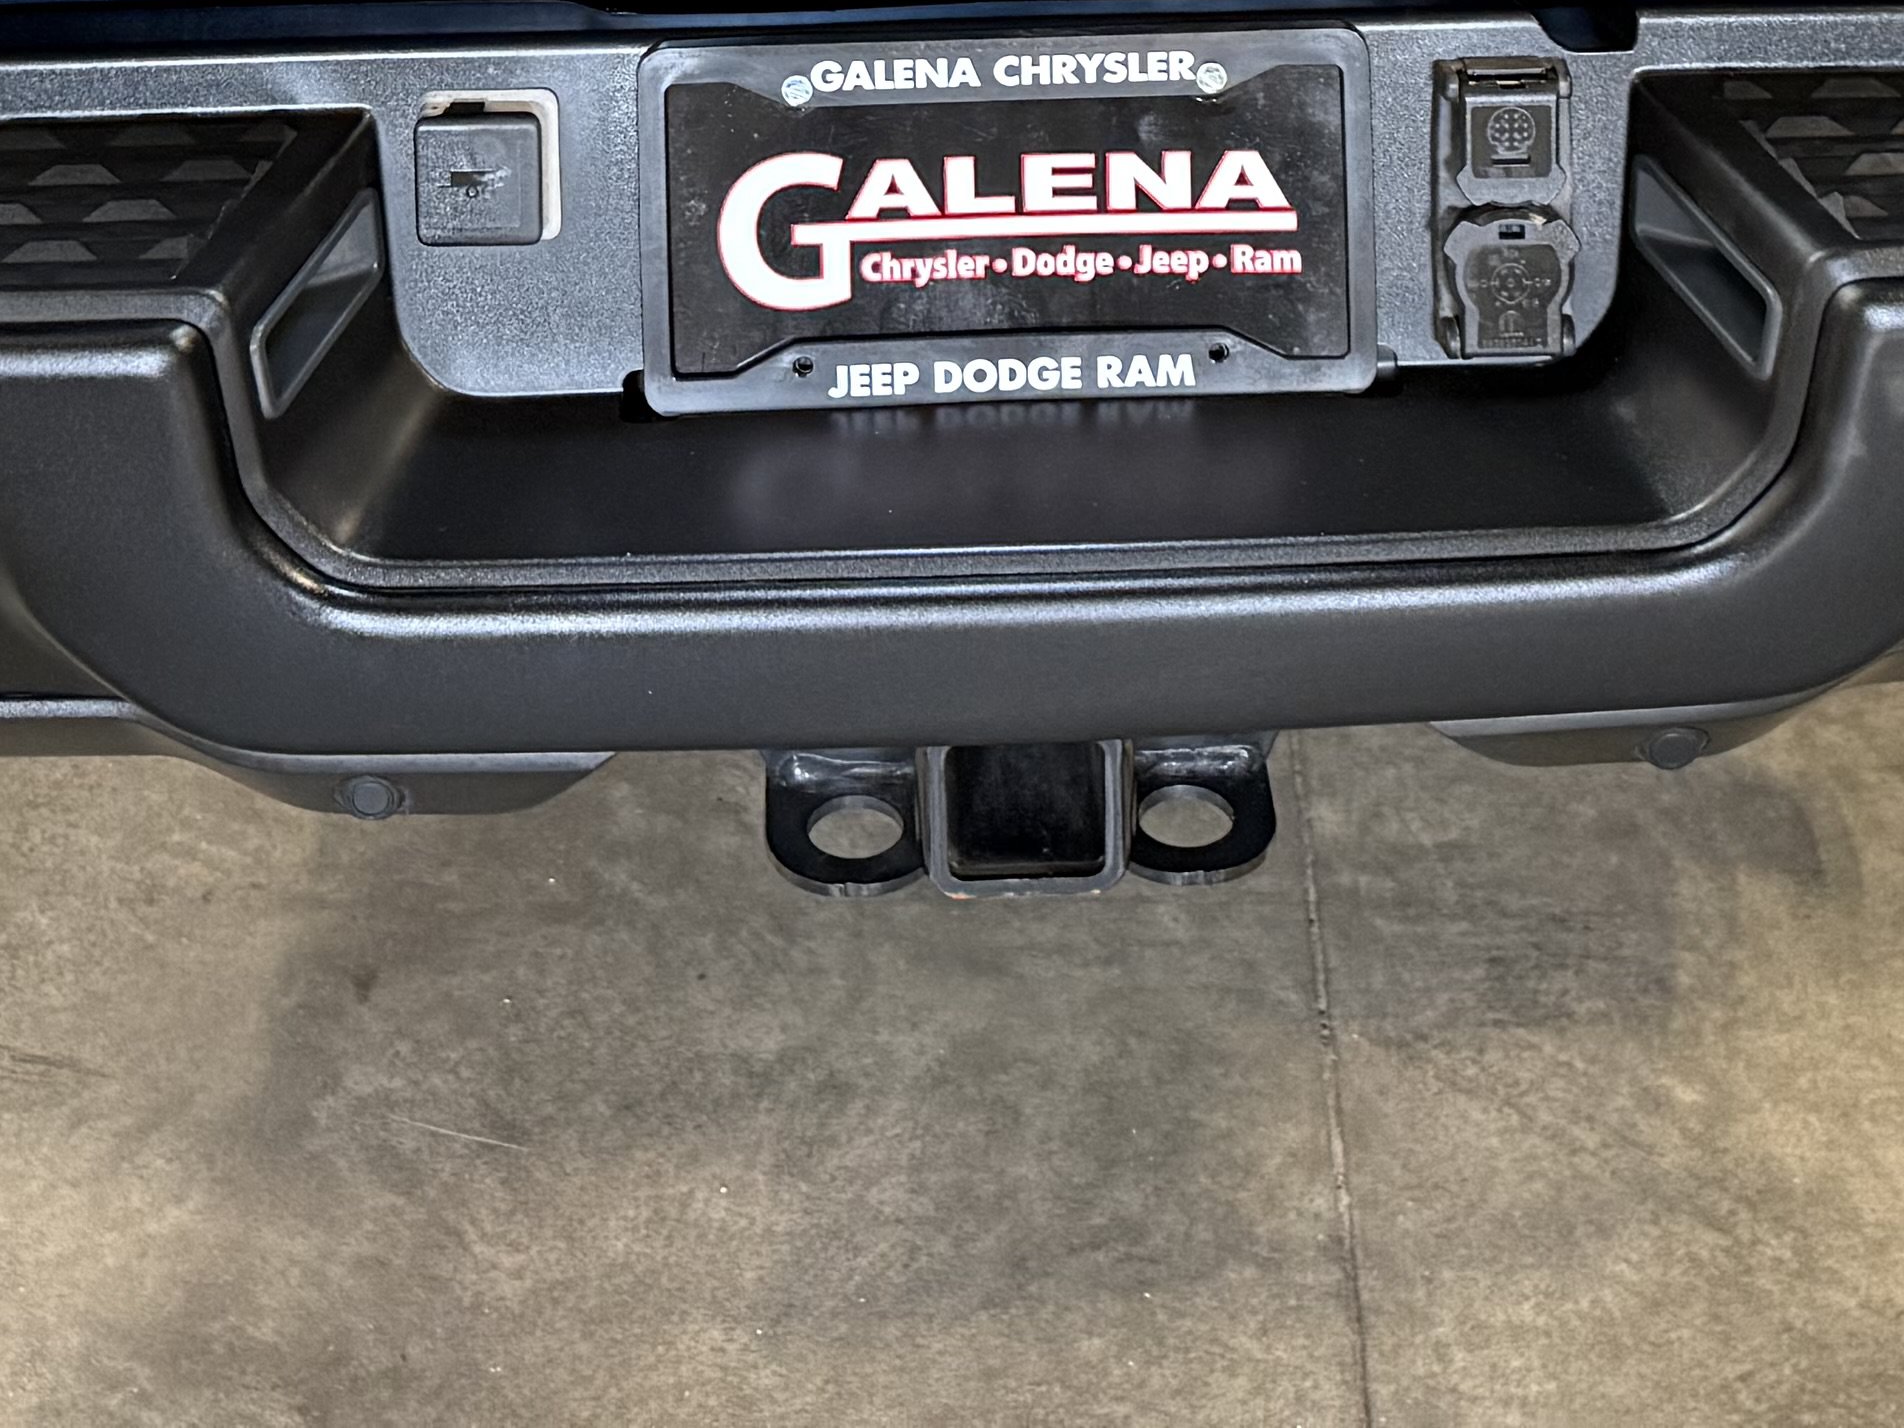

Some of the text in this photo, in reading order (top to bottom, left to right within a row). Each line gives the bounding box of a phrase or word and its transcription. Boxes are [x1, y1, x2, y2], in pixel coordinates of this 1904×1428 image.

[809, 50, 1196, 92] GALENA CHRYSLER
[717, 149, 1294, 312] GALENA
[860, 244, 1303, 288] Chrysler Dodge Jeep Ram
[828, 353, 1196, 399] JEEP DODGE RAM
